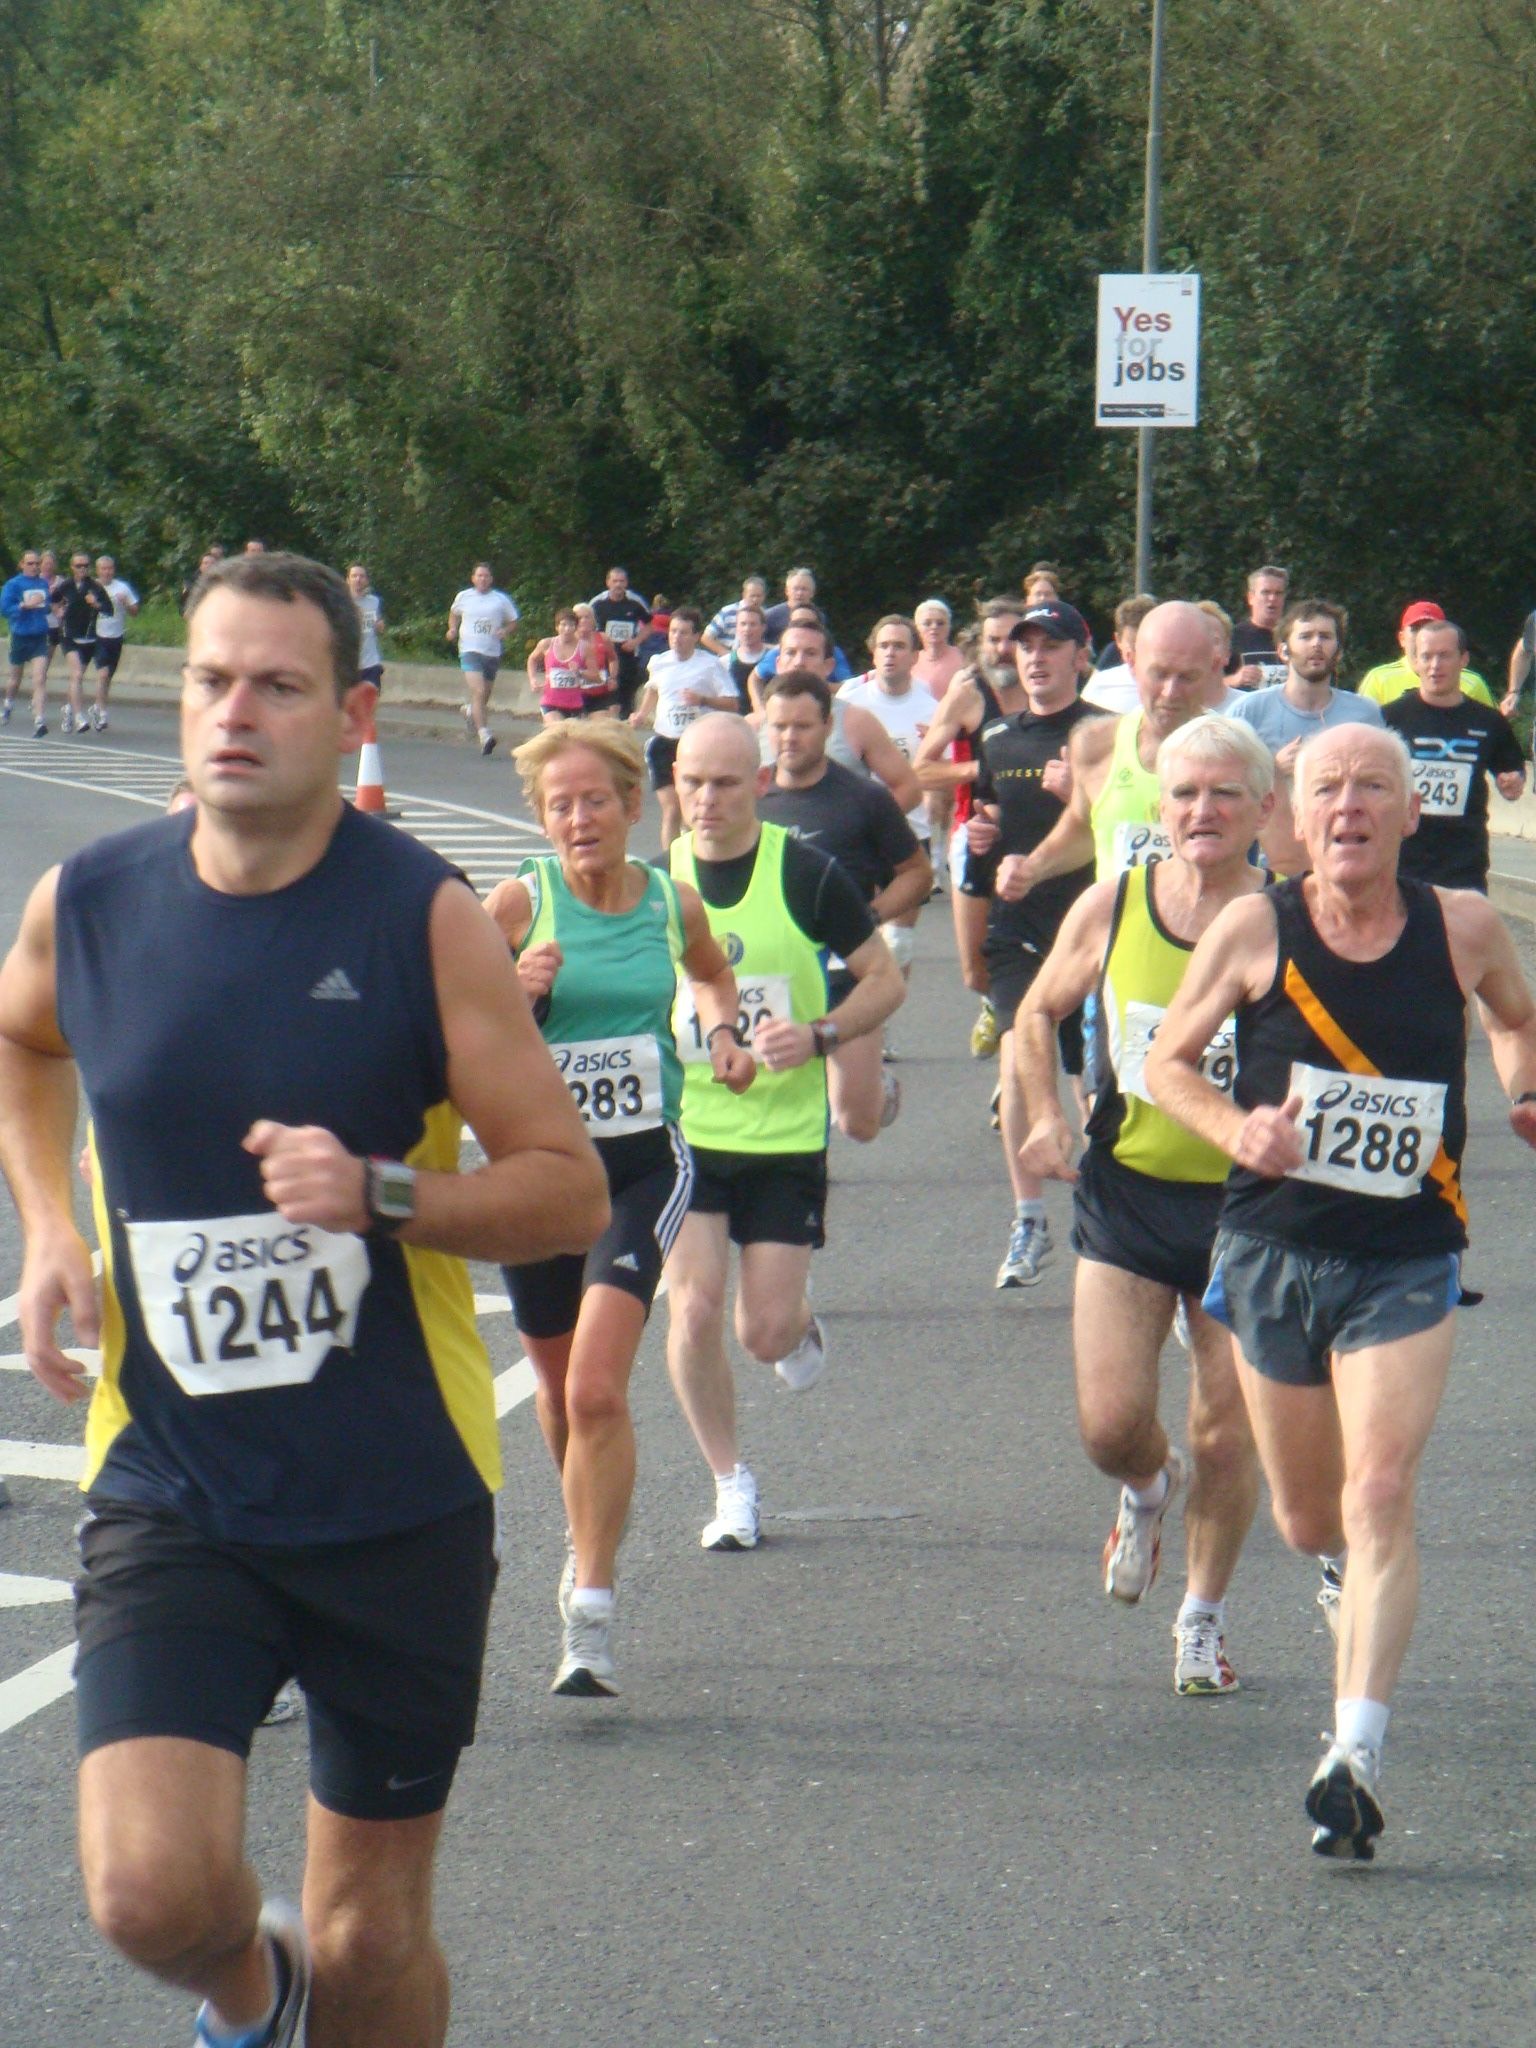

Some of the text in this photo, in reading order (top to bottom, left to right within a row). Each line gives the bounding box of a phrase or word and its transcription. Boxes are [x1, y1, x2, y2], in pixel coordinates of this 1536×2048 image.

[1113, 306, 1172, 332] Yes
[1115, 331, 1163, 356] for
[1113, 356, 1185, 387] jobs
[573, 1048, 632, 1074] asics
[567, 1074, 643, 1121] 283
[1350, 1089, 1418, 1118] asics
[1304, 1111, 1422, 1177] 1288
[214, 1228, 312, 1273] asics
[171, 1267, 347, 1365] 1244
